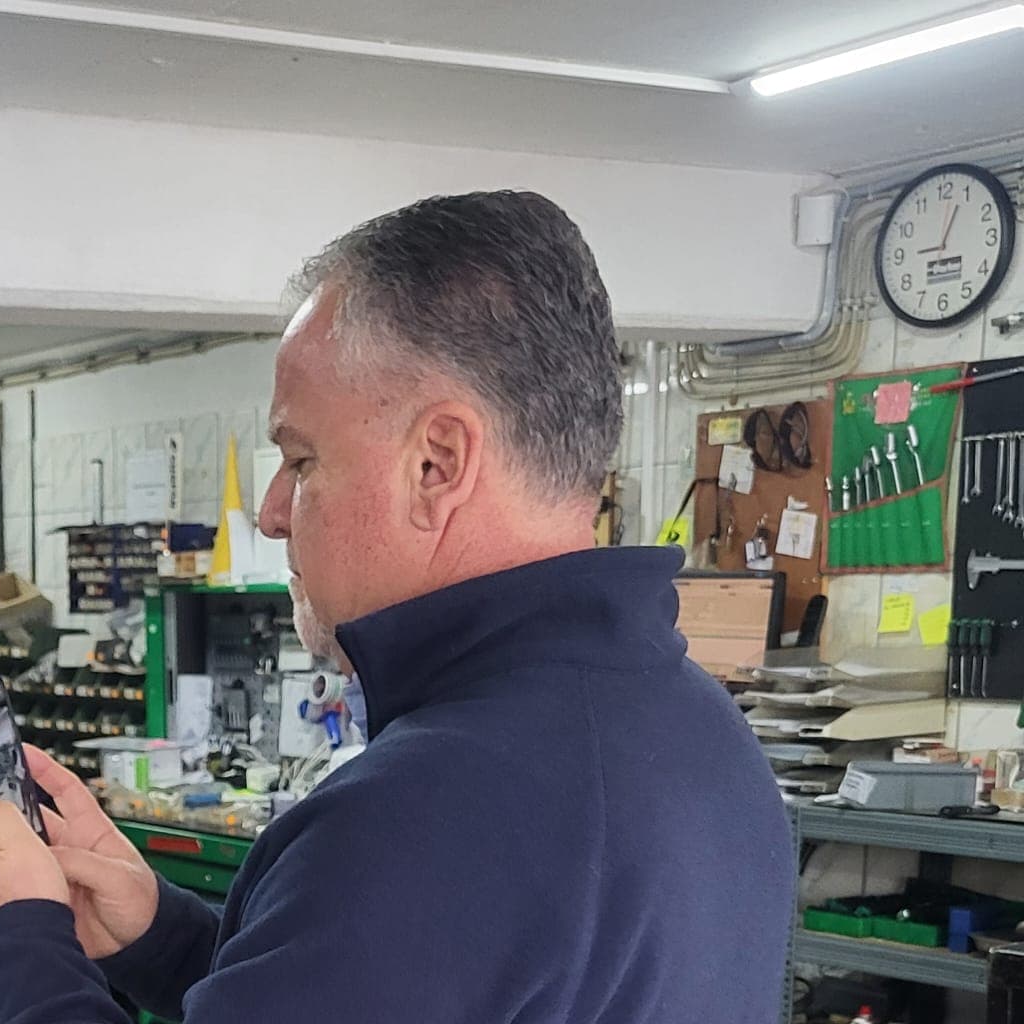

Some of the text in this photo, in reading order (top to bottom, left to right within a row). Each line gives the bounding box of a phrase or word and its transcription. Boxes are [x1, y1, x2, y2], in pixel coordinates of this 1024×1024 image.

[937, 182, 953, 200] 12
[964, 185, 970, 201] 1
[916, 198, 927, 215] 11
[980, 203, 992, 222] 2
[899, 221, 914, 239] 10
[985, 228, 997, 247] 3
[894, 248, 905, 266] 9
[977, 259, 989, 276] 4
[900, 273, 912, 291] 8
[960, 281, 972, 299] 5
[916, 290, 926, 308] 7
[937, 293, 949, 311] 6
